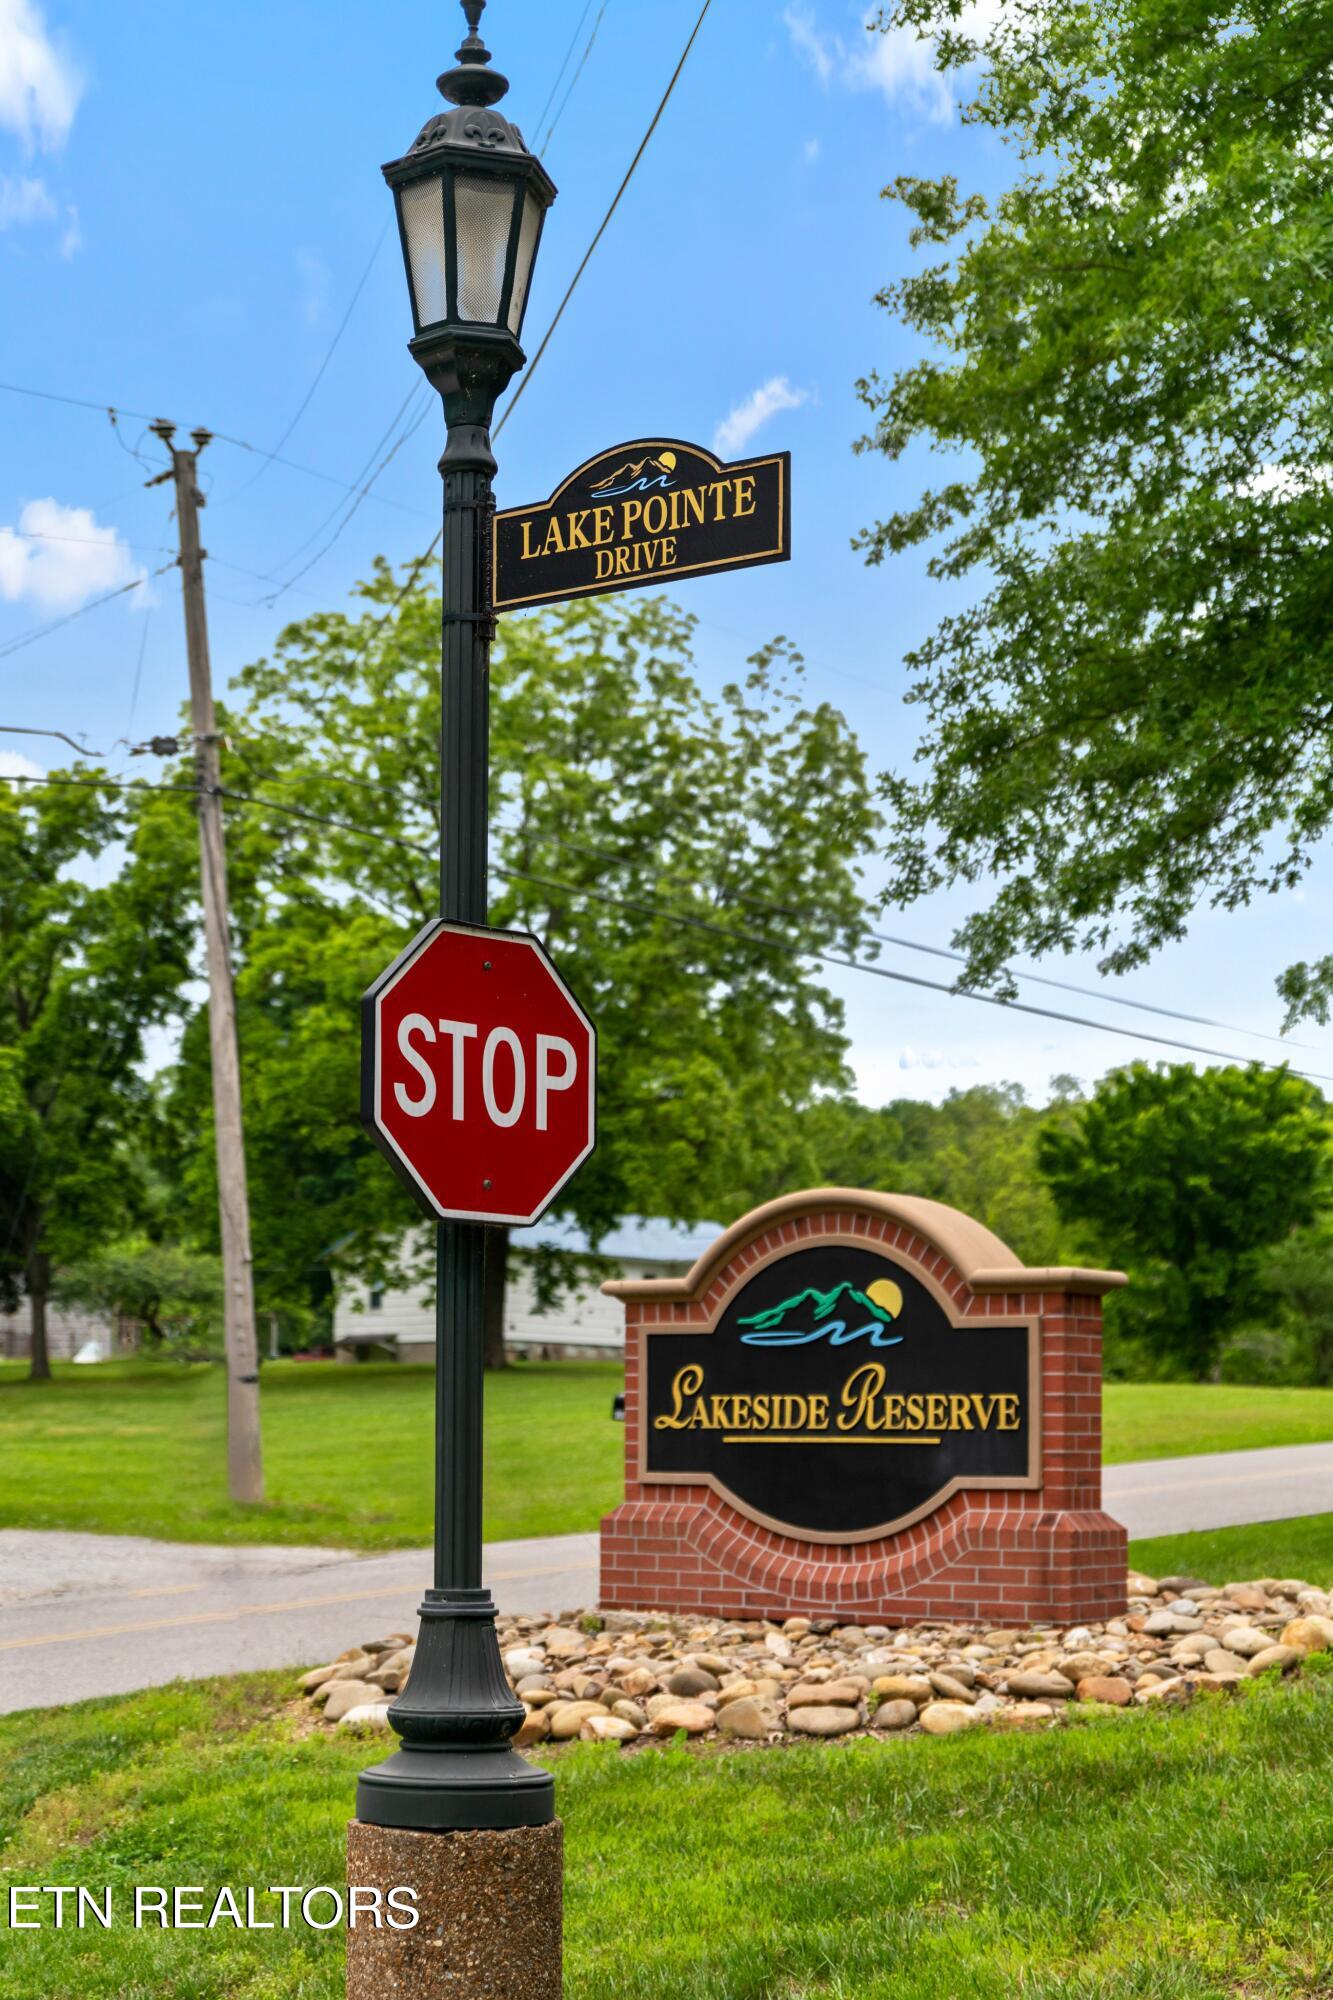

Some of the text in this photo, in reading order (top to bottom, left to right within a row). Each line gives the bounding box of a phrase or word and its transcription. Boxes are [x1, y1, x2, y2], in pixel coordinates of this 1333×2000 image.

[520, 475, 757, 560] LAKE POINTE
[594, 536, 678, 580] DRIVE
[393, 1012, 578, 1131] STOP
[654, 1361, 1020, 1432] LAKESIDE RESERVE
